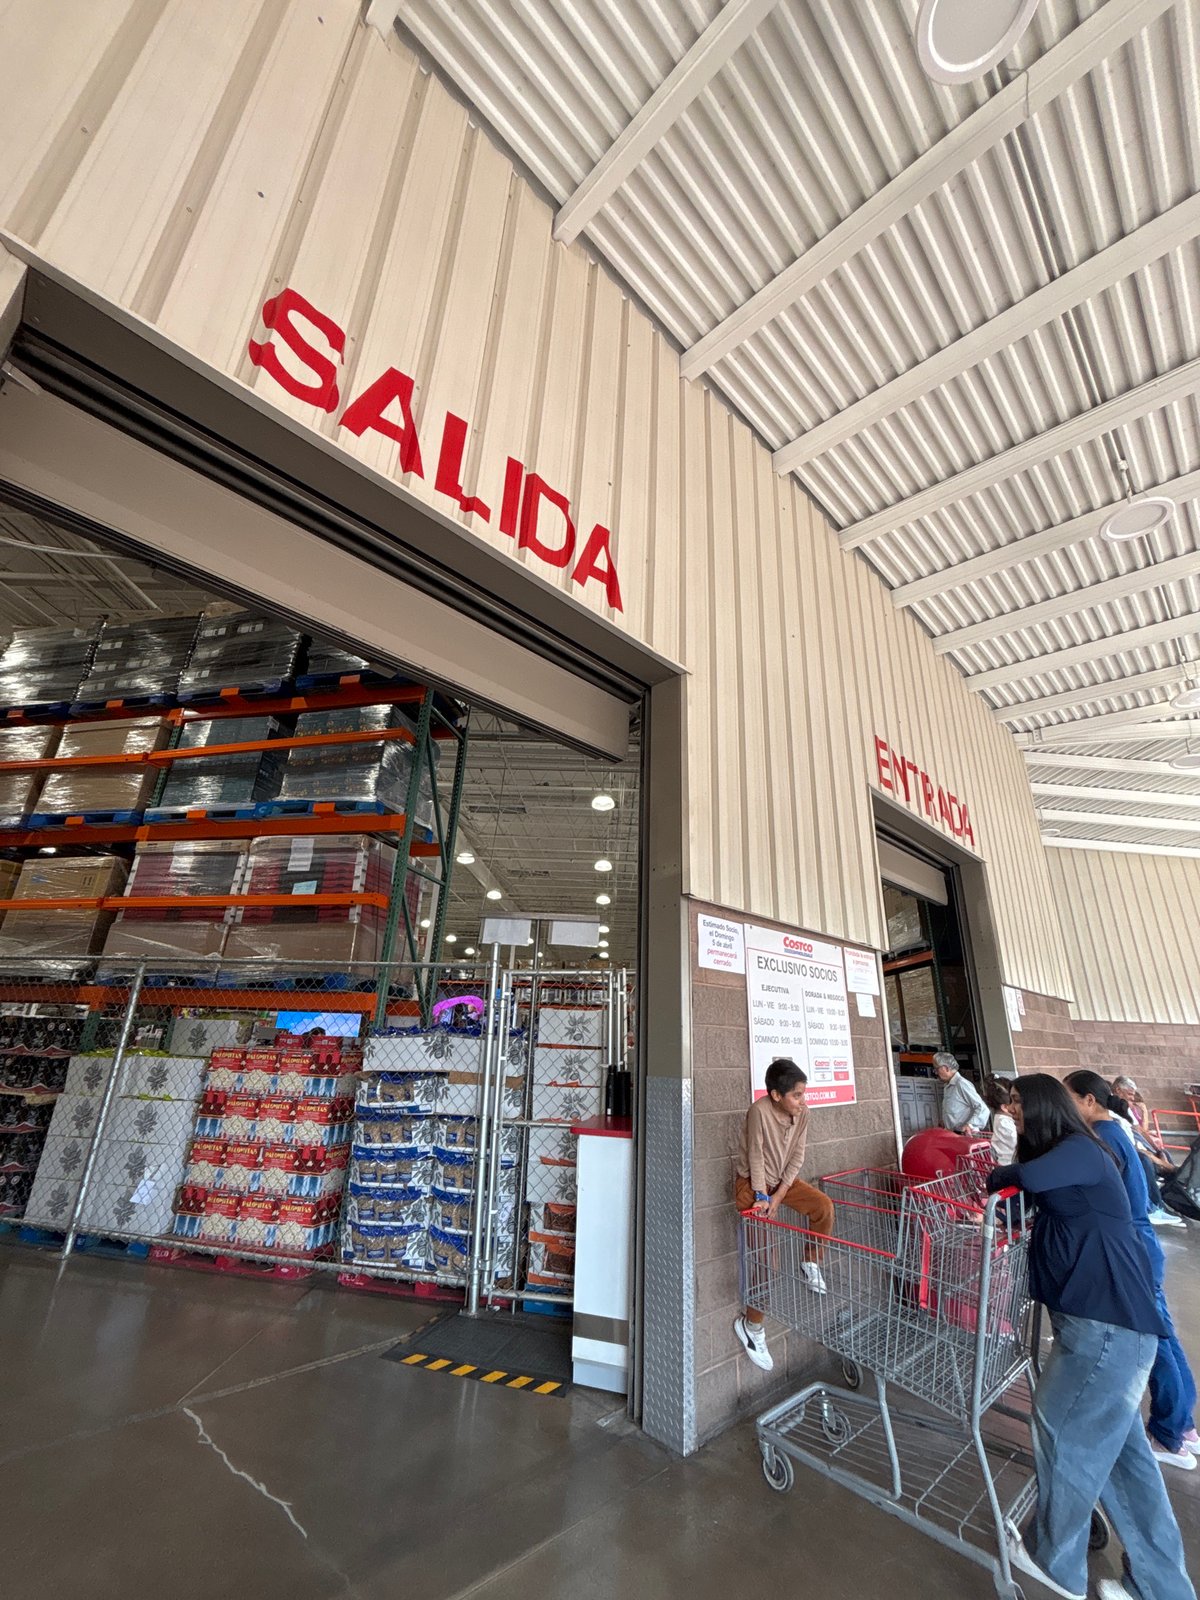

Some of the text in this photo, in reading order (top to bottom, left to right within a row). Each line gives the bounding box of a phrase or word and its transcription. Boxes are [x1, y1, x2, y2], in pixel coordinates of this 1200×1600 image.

[249, 288, 623, 613] SALIDA
[875, 735, 975, 846] ENTRADA
[702, 920, 725, 930] Estimado
[714, 930, 734, 942] Domingo
[757, 956, 807, 977] EXCLUSIVO
[809, 966, 838, 982] SOCIOS
[761, 984, 789, 994] EJECUTIVA
[805, 990, 822, 999] DORADA
[753, 1000, 763, 1008] LUN
[767, 1001, 775, 1010] VIE
[753, 1016, 774, 1026] SÁBADO
[755, 1035, 779, 1044] DOMINGO
